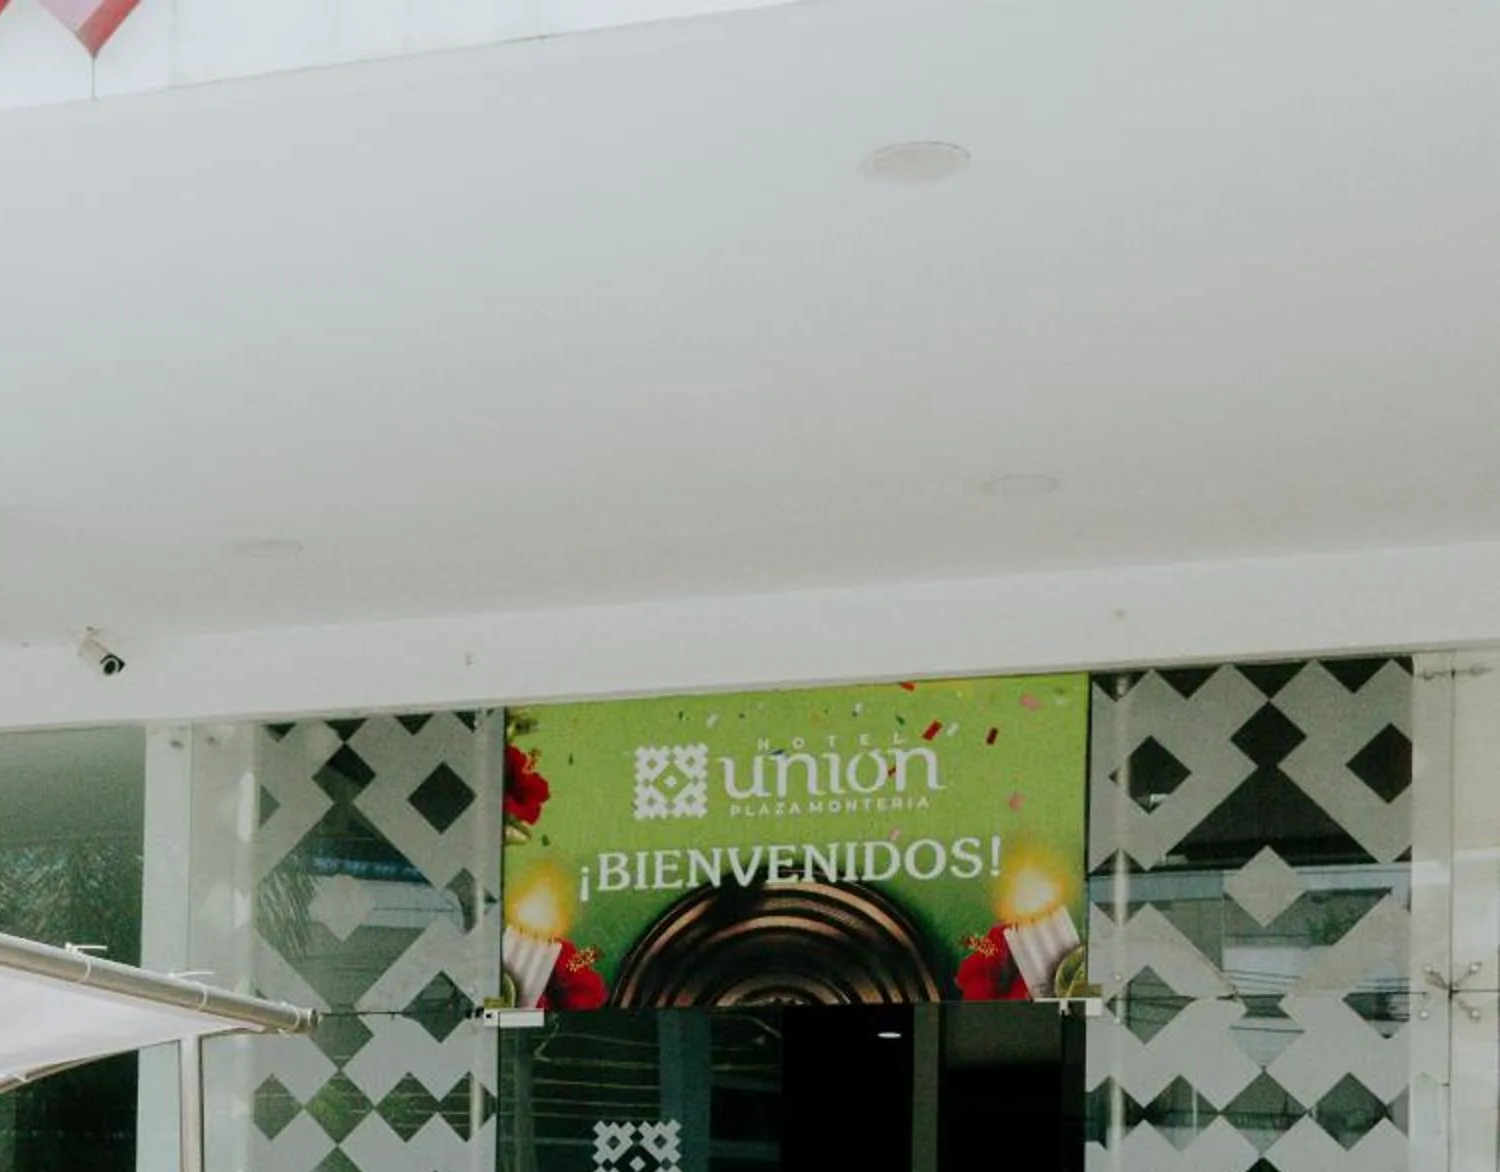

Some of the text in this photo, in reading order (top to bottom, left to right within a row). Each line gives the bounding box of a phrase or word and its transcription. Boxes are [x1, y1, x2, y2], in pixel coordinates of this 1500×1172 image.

[757, 733, 906, 751] HOTEL
[730, 803, 801, 817] PLAZA
[579, 835, 1001, 902] ¡BIENVENIDOS!
